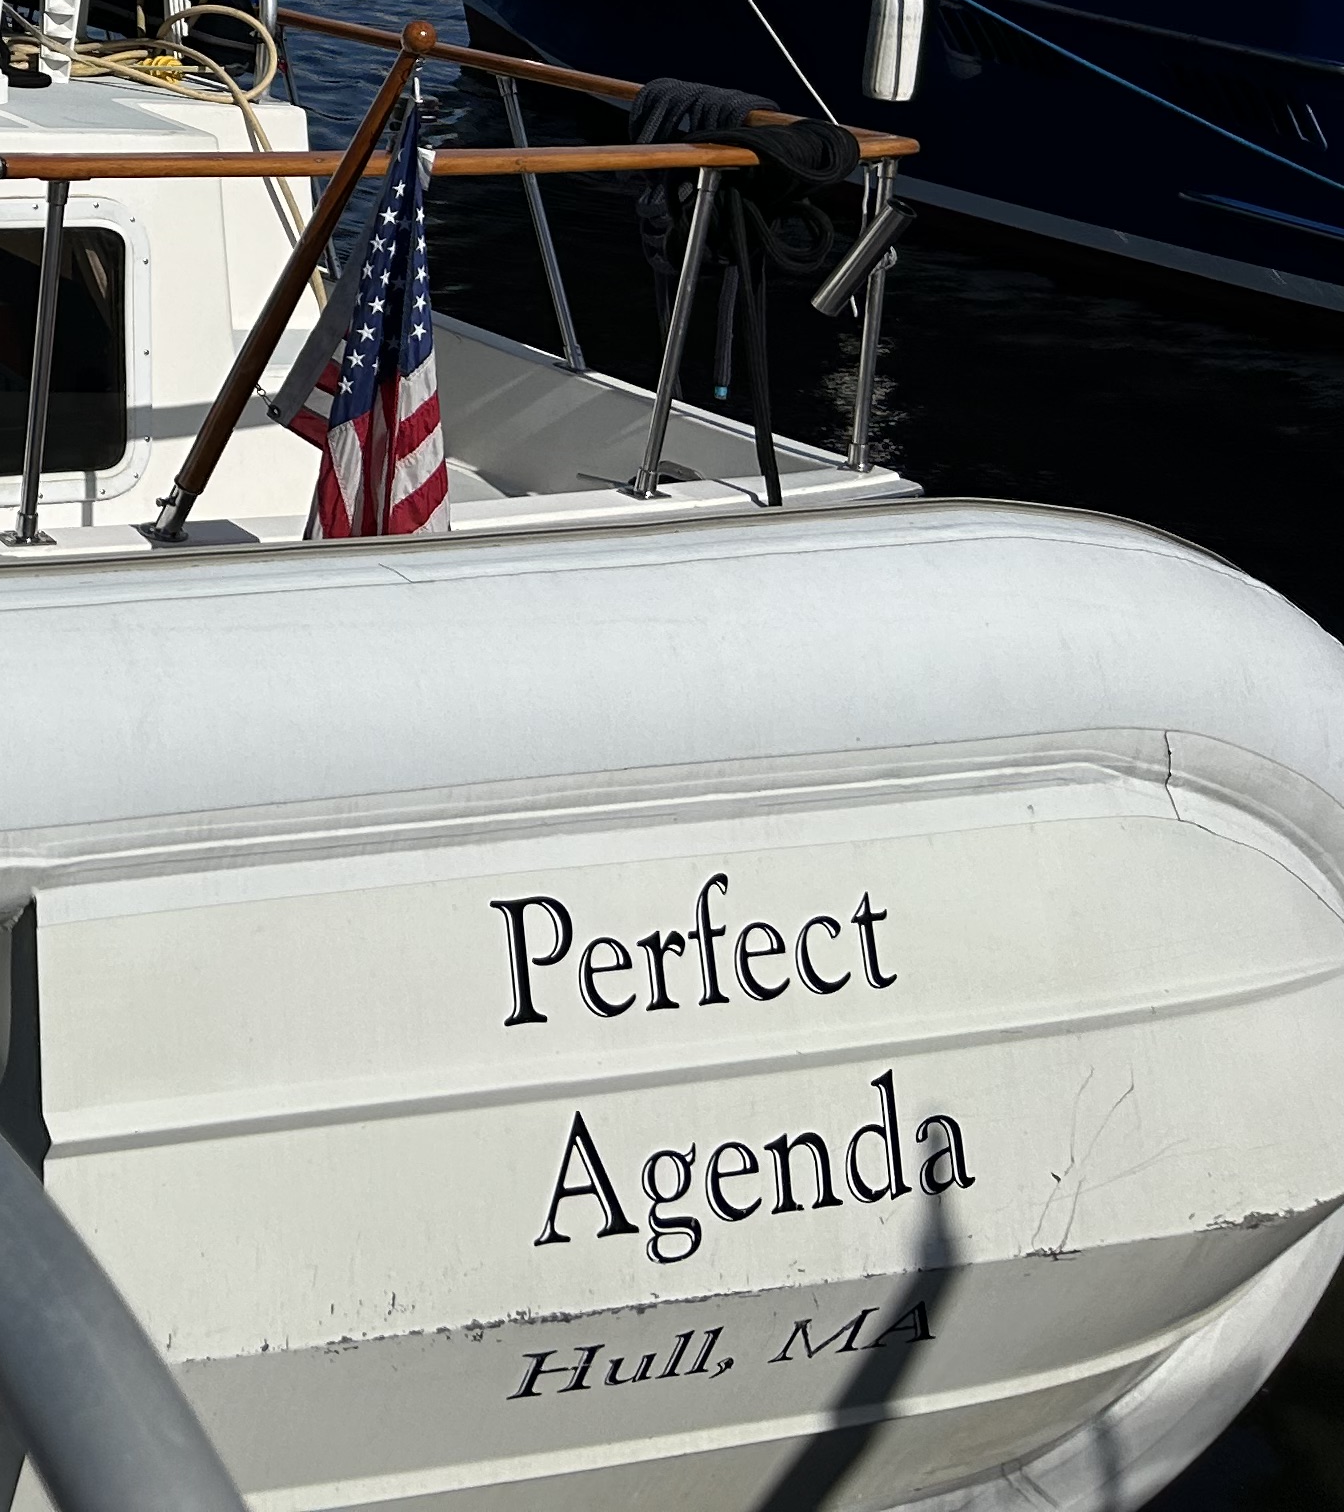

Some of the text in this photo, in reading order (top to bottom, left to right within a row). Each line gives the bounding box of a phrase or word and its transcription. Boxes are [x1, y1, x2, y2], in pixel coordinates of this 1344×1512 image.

[489, 872, 898, 1026] Perfect
[533, 1068, 976, 1264] Agenda
[506, 1299, 936, 1400] Hull, MA
